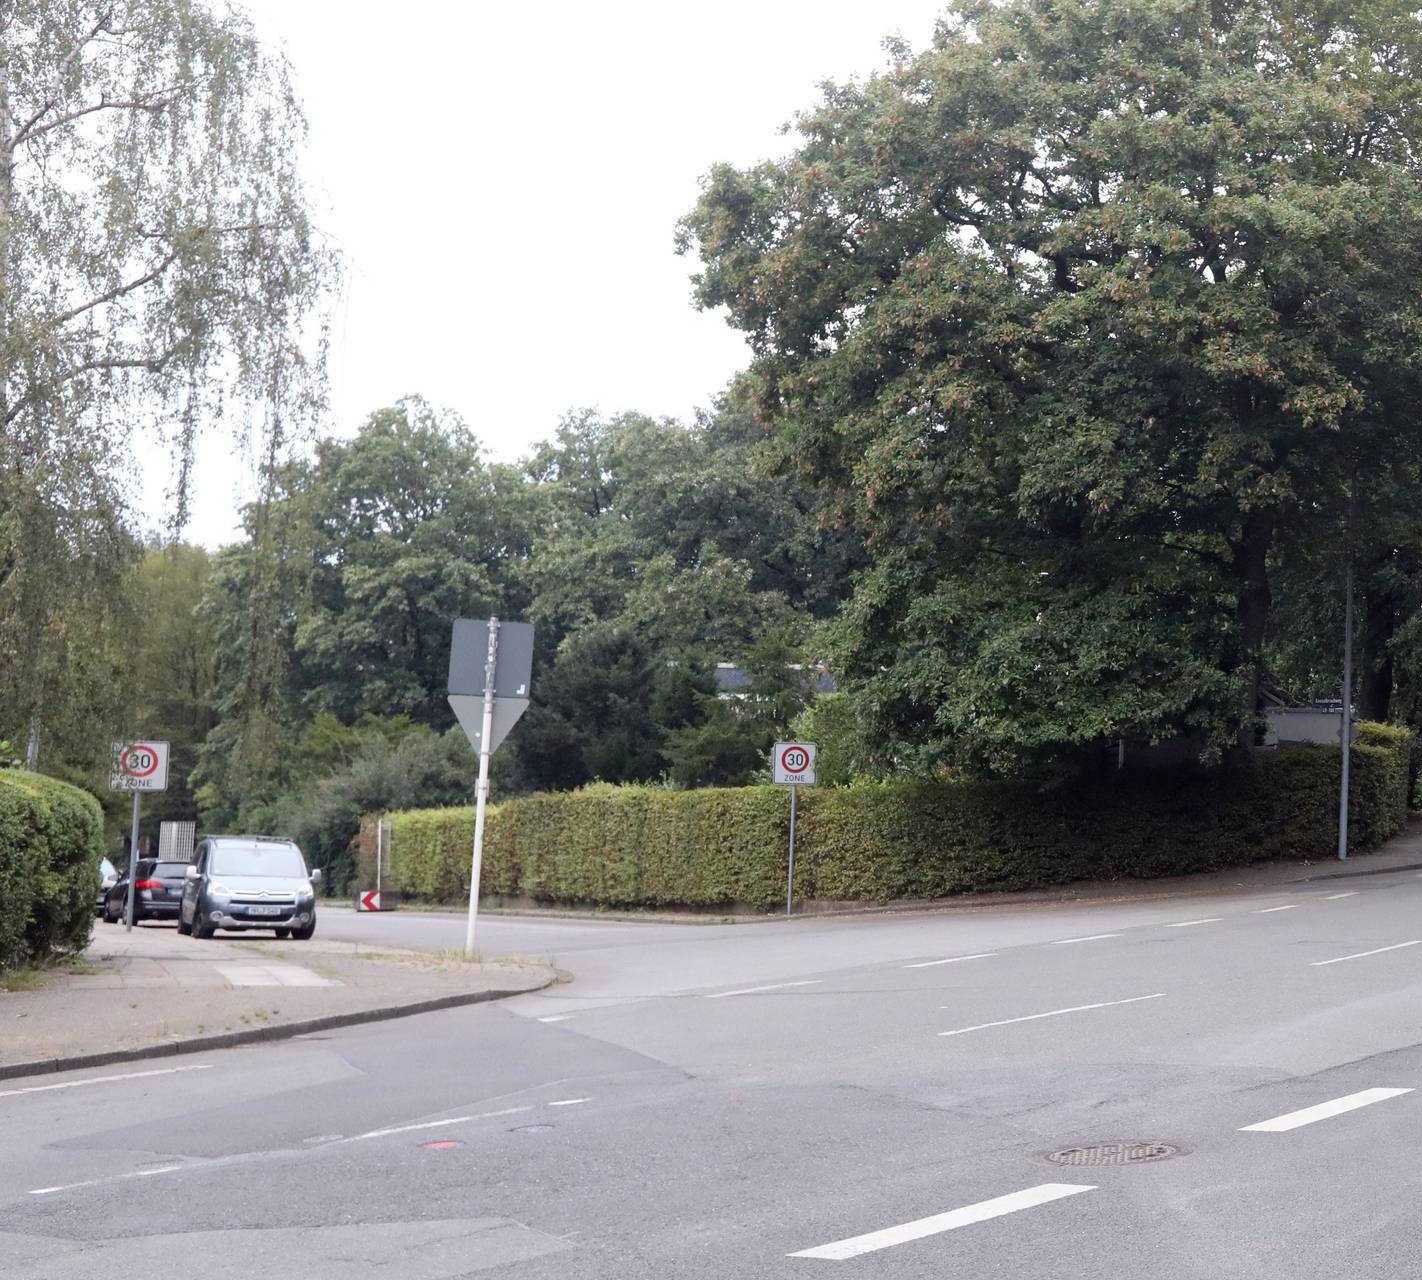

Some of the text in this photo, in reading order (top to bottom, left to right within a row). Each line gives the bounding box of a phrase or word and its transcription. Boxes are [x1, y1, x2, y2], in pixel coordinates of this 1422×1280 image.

[129, 754, 151, 769] 30
[788, 754, 804, 766] 30
[785, 774, 805, 782] ZONE
